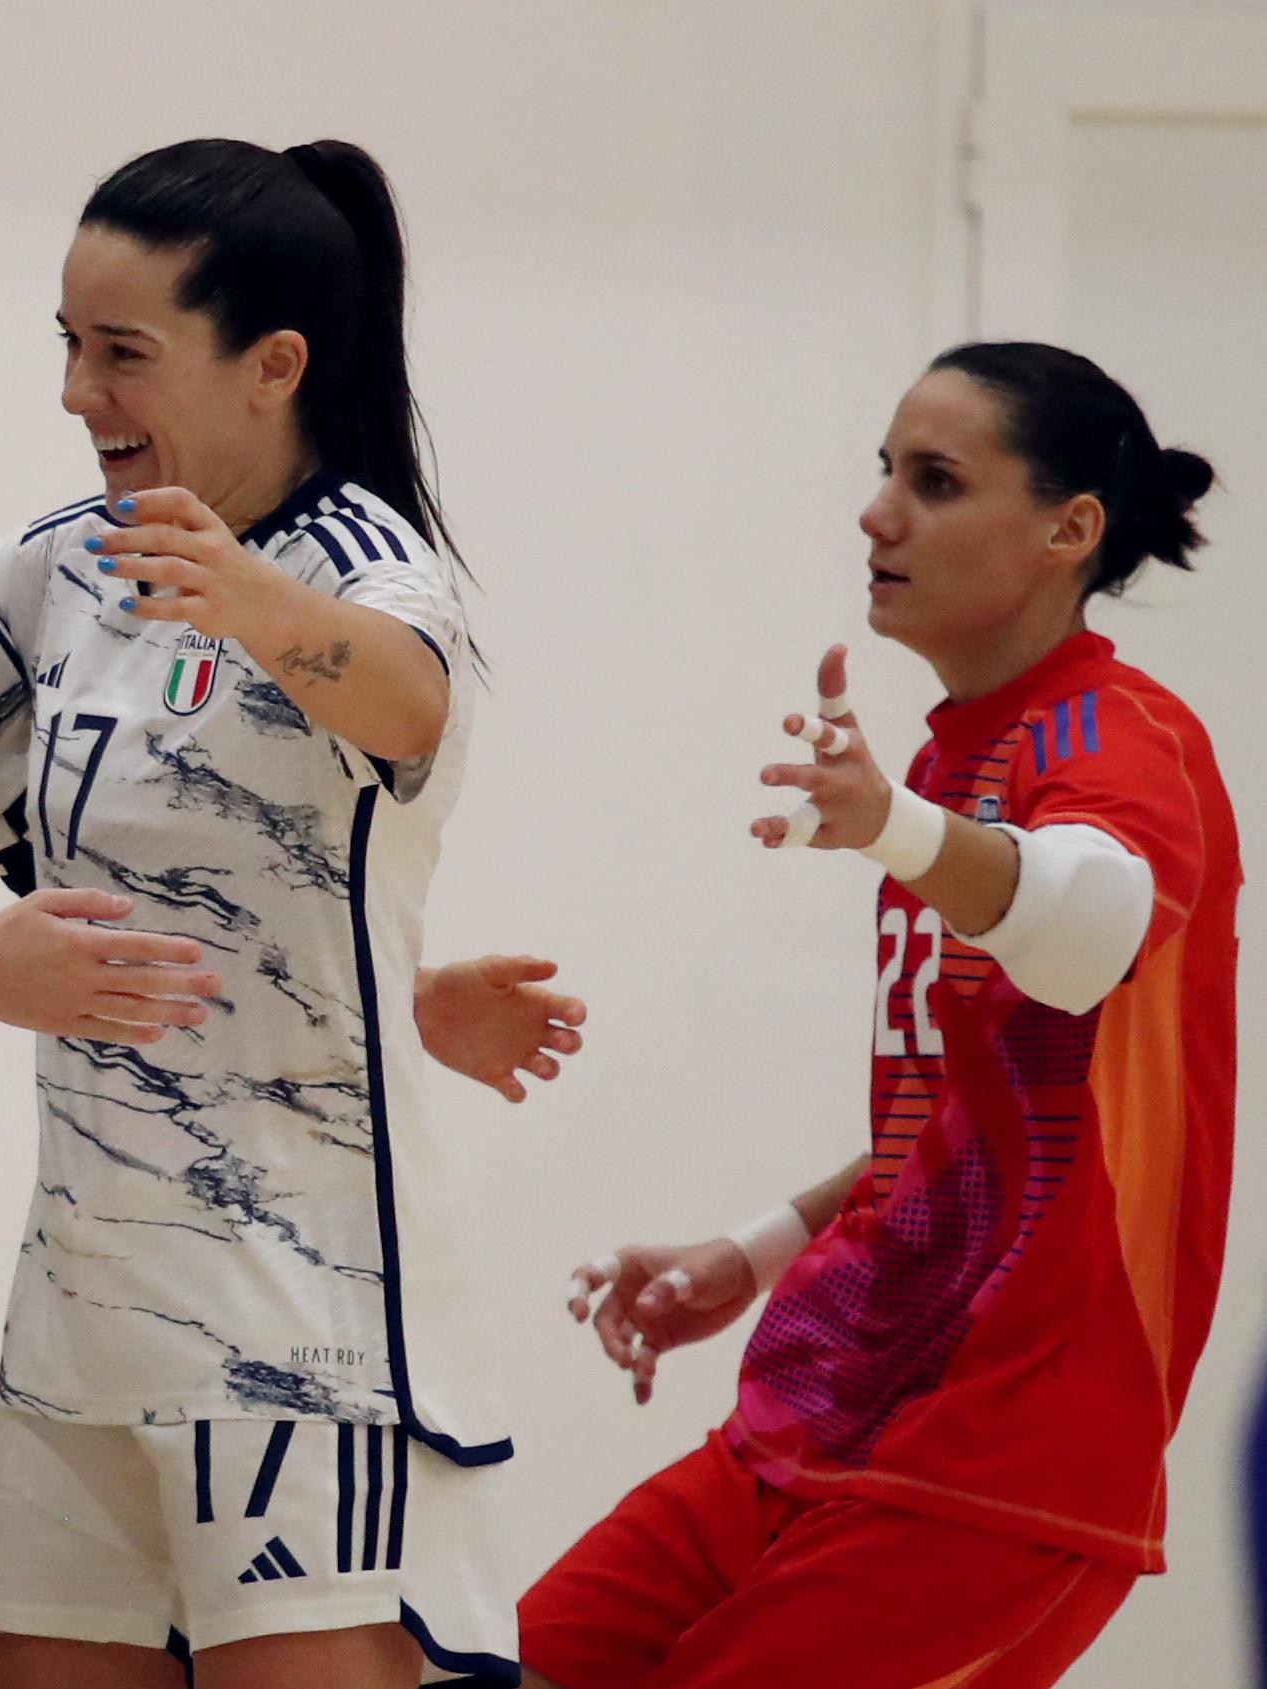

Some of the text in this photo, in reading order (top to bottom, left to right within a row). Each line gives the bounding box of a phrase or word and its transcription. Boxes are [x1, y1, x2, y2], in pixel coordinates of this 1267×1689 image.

[179, 634, 217, 651] ITALIA
[37, 710, 119, 861] 17
[874, 906, 945, 1056] 22
